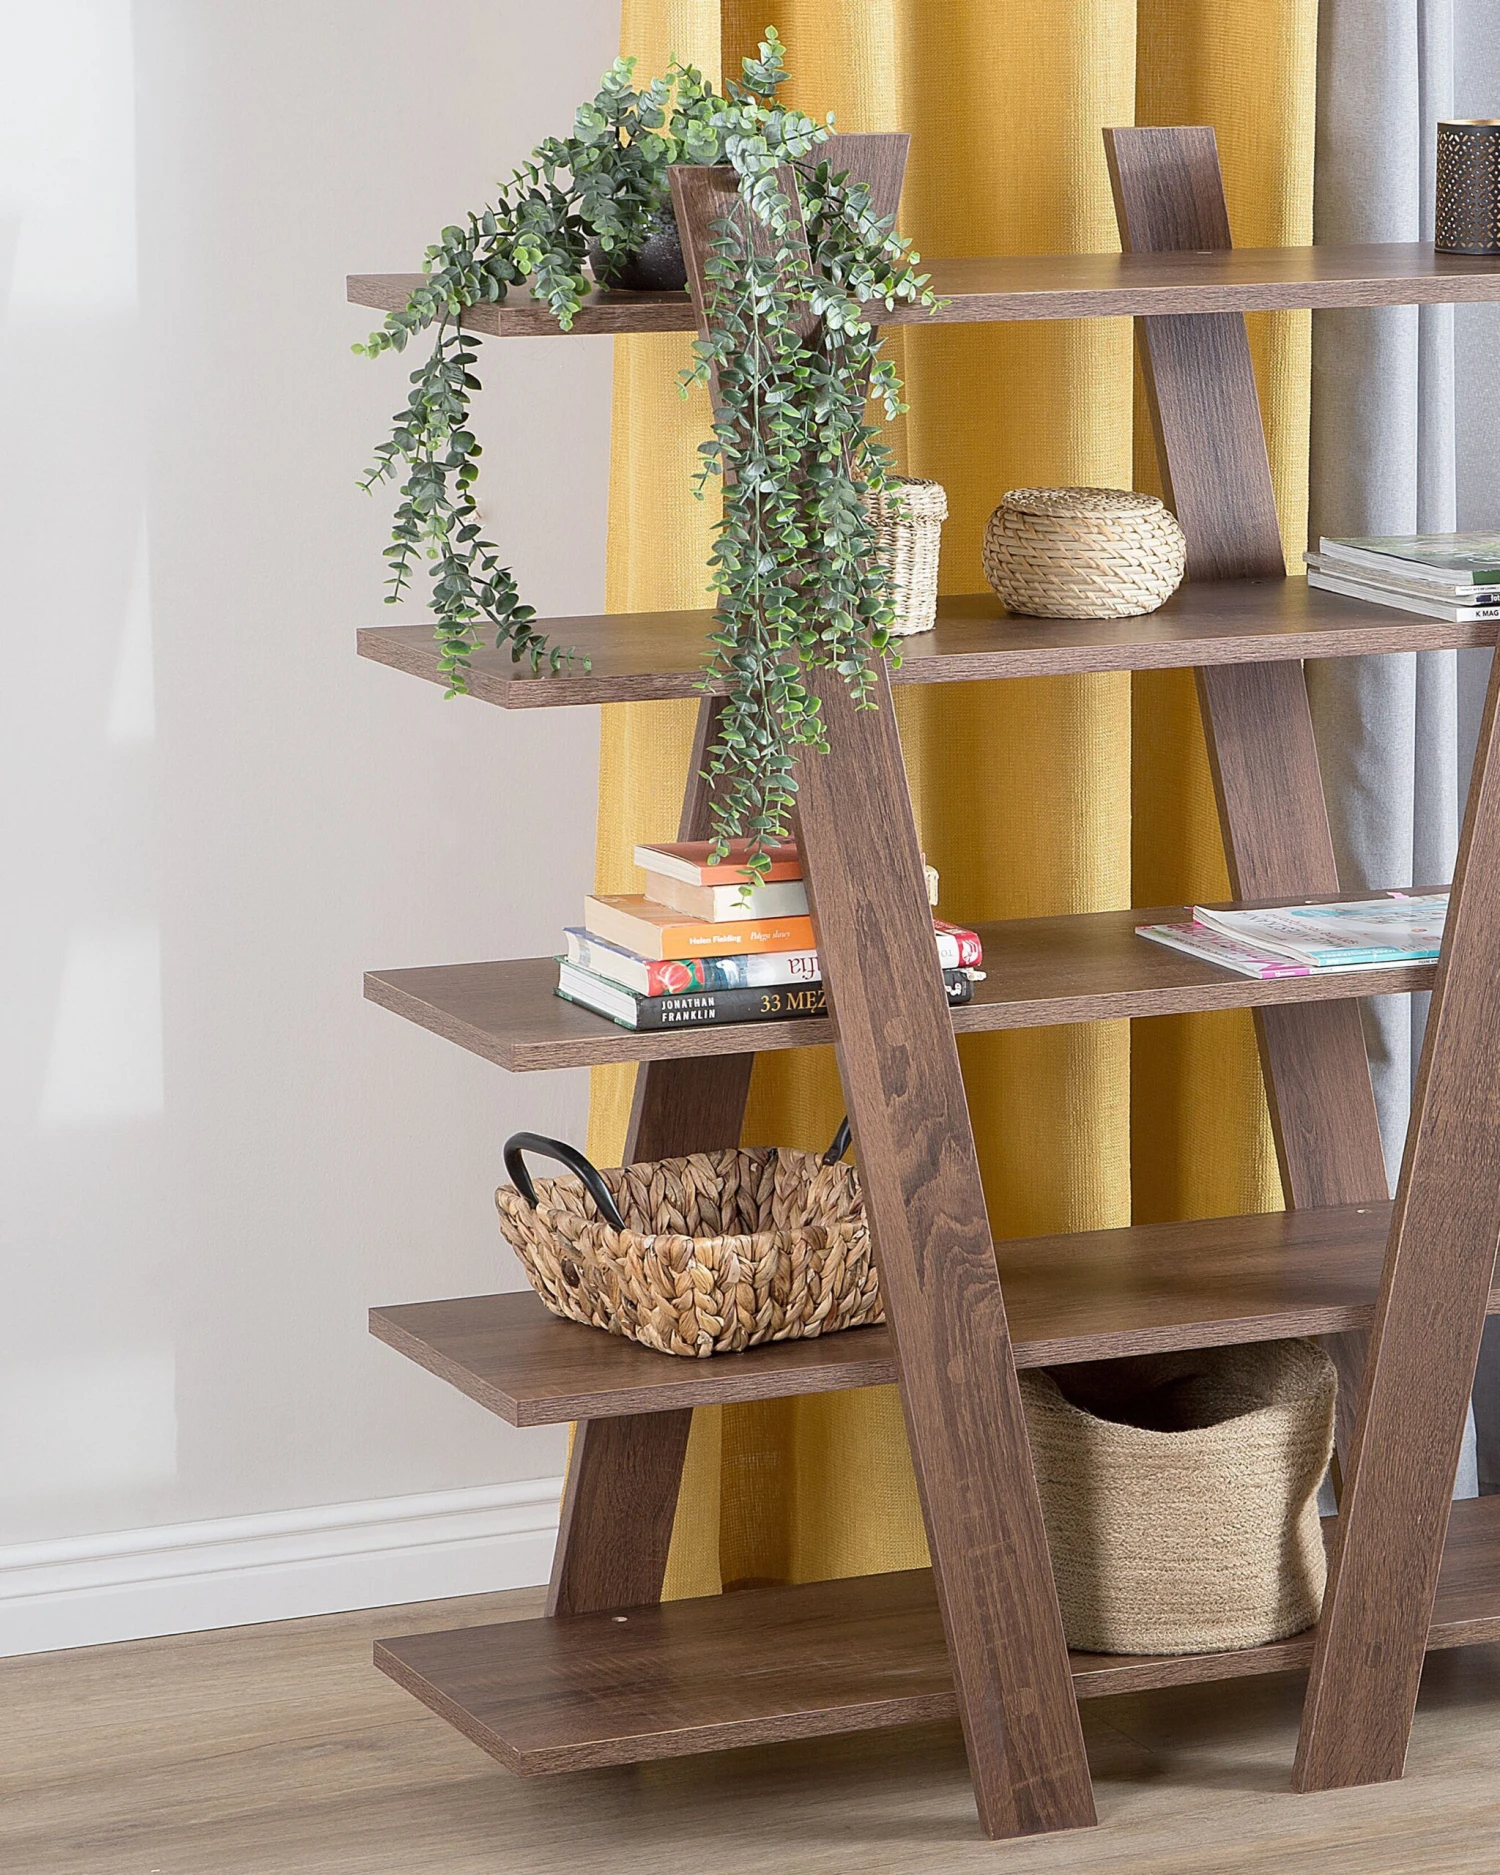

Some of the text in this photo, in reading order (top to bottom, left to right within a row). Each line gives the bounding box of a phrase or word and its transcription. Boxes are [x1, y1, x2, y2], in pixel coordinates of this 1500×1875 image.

[689, 935, 742, 945] Helen Fielding
[661, 997, 715, 1010] JONATHAN
[760, 994, 781, 1013] 33
[662, 1009, 716, 1023] FRANKLIN
